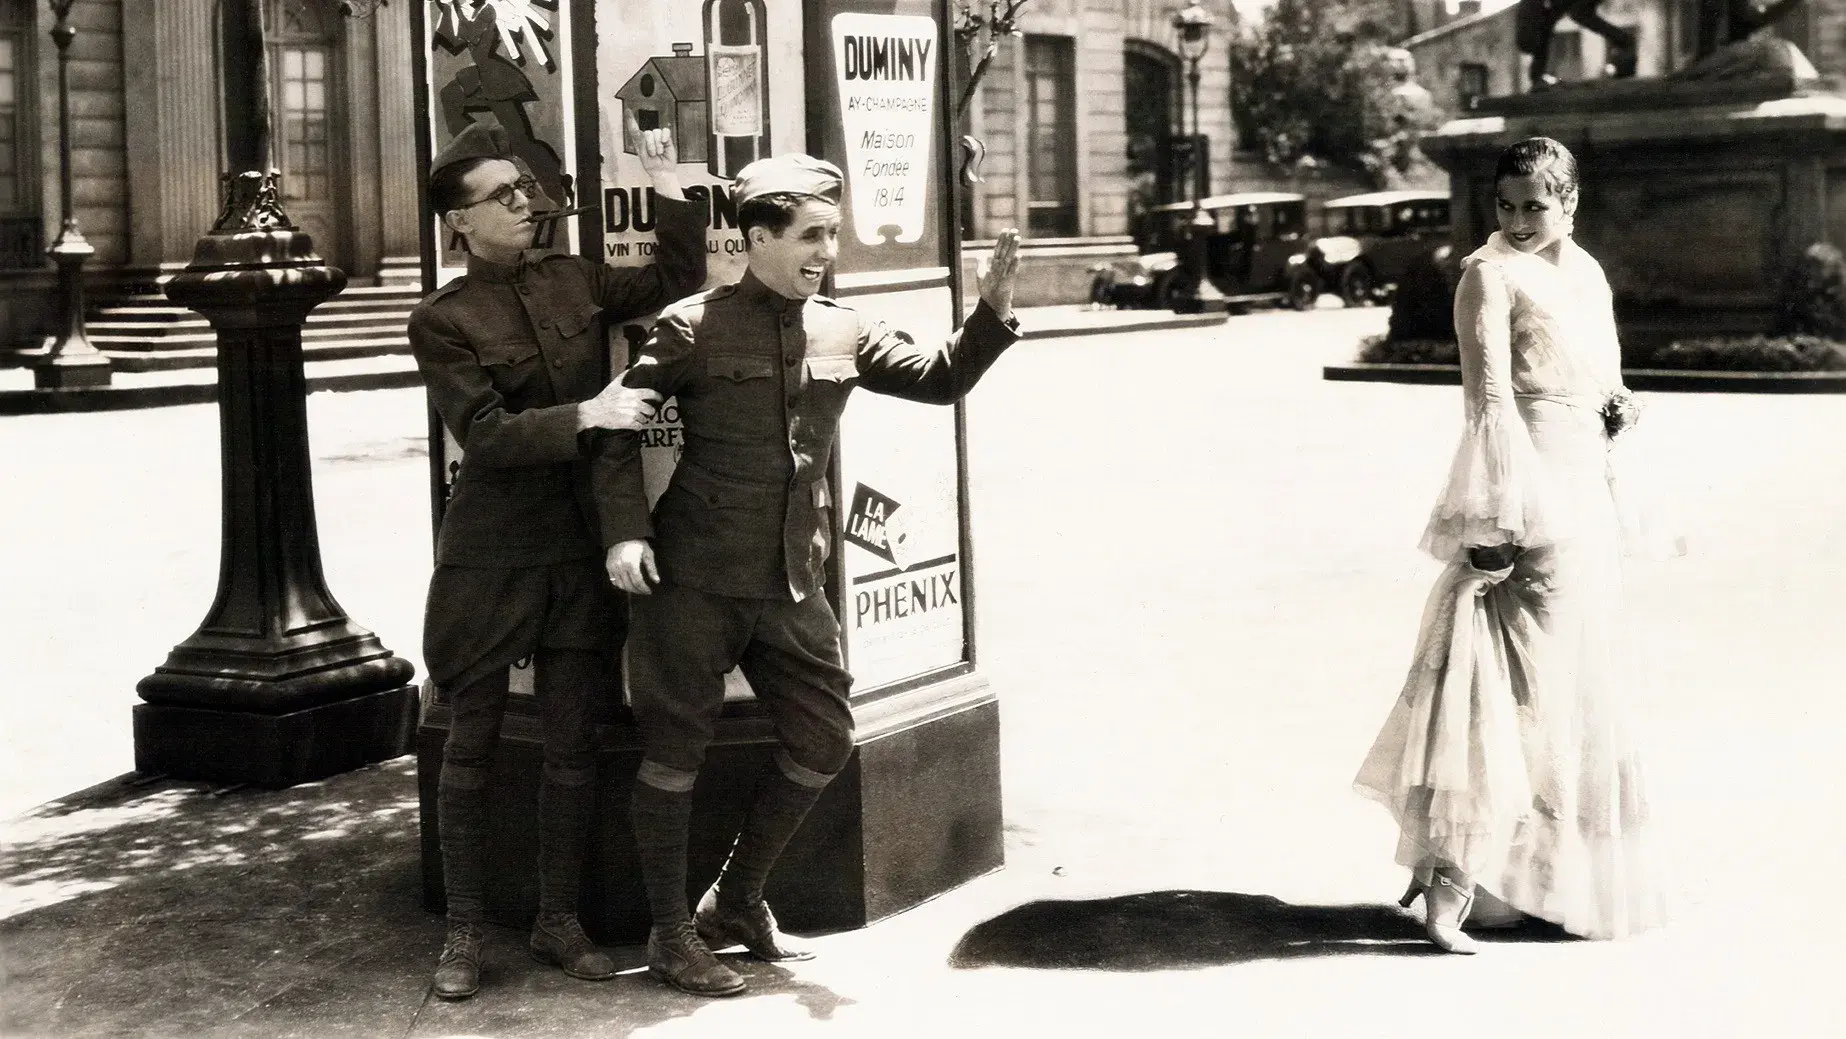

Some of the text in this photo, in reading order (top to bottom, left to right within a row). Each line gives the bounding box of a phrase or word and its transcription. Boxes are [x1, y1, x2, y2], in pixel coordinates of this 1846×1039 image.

[844, 35, 932, 81] DUMINY
[860, 128, 915, 149] Maison
[873, 186, 905, 207] 1814
[606, 242, 630, 257] VIN
[865, 497, 885, 523] LA
[850, 513, 888, 550] LAME
[855, 570, 958, 630] PHENIX
